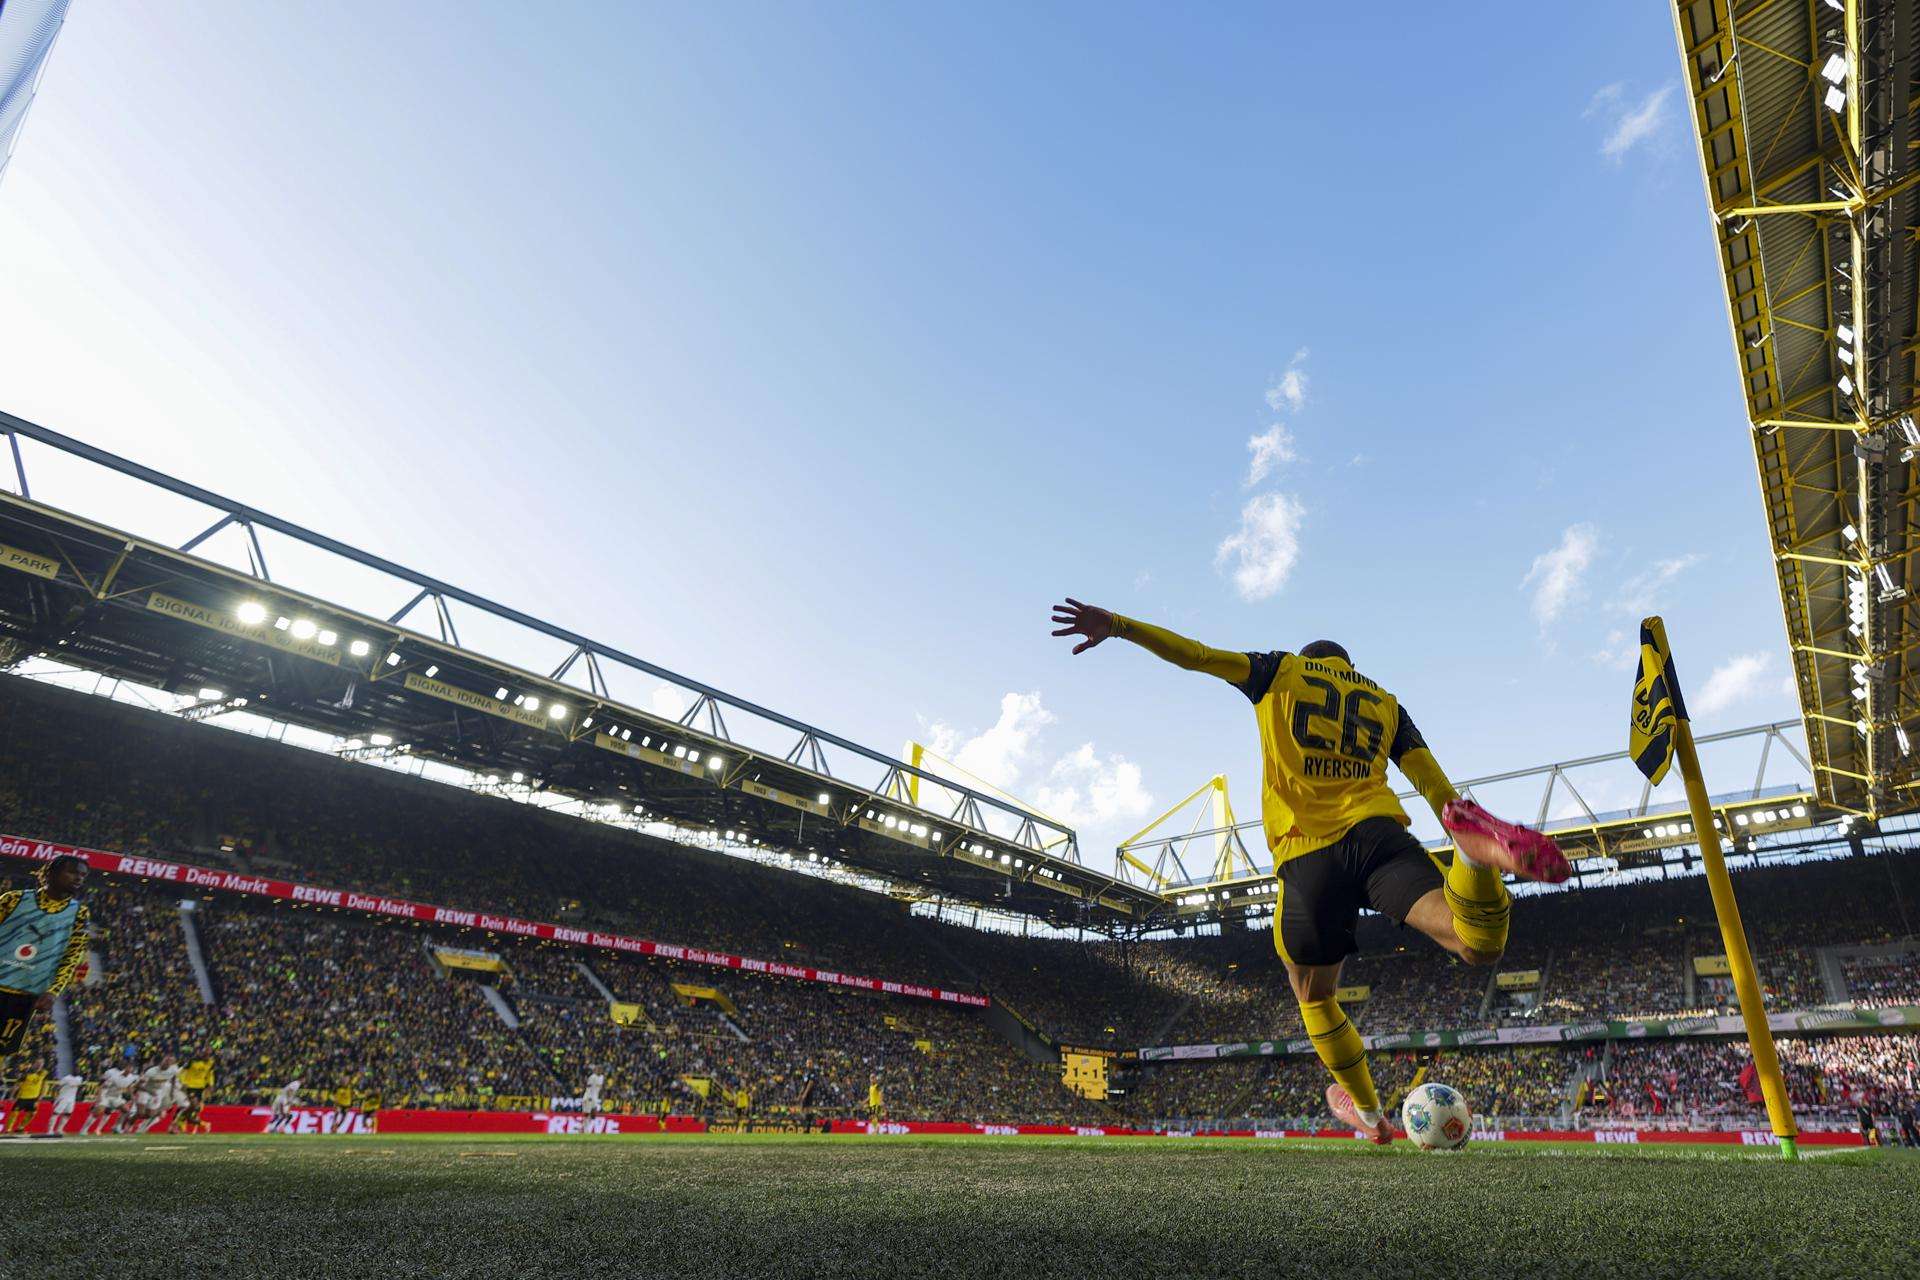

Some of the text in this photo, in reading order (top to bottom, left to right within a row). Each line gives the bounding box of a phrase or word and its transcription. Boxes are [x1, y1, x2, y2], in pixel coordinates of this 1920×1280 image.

[10, 554, 51, 572] PARK
[153, 597, 216, 625] SIGNAL
[219, 617, 267, 640] IDUNA
[409, 677, 544, 724] SIGNAL IDUNA PARK
[1293, 674, 1384, 762] 26
[1304, 757, 1371, 779] RYERSON
[0, 841, 29, 857] ein
[118, 858, 179, 880] REWE
[186, 868, 220, 886] Dein
[223, 875, 269, 894] Markt
[292, 886, 342, 905] REWE
[347, 894, 375, 911] Dein
[377, 899, 416, 917] Markt
[434, 908, 475, 926] REWE
[480, 916, 504, 929] Dein
[506, 920, 538, 936] Markt
[553, 928, 588, 943] REWE
[592, 934, 613, 946] Dein
[614, 938, 641, 952] Markt
[655, 944, 684, 959] REWE
[687, 950, 705, 962] Dein
[706, 953, 729, 965] Markt
[740, 958, 767, 972] REWE
[816, 971, 839, 983] REWE
[1595, 1131, 1638, 1143] REWE
